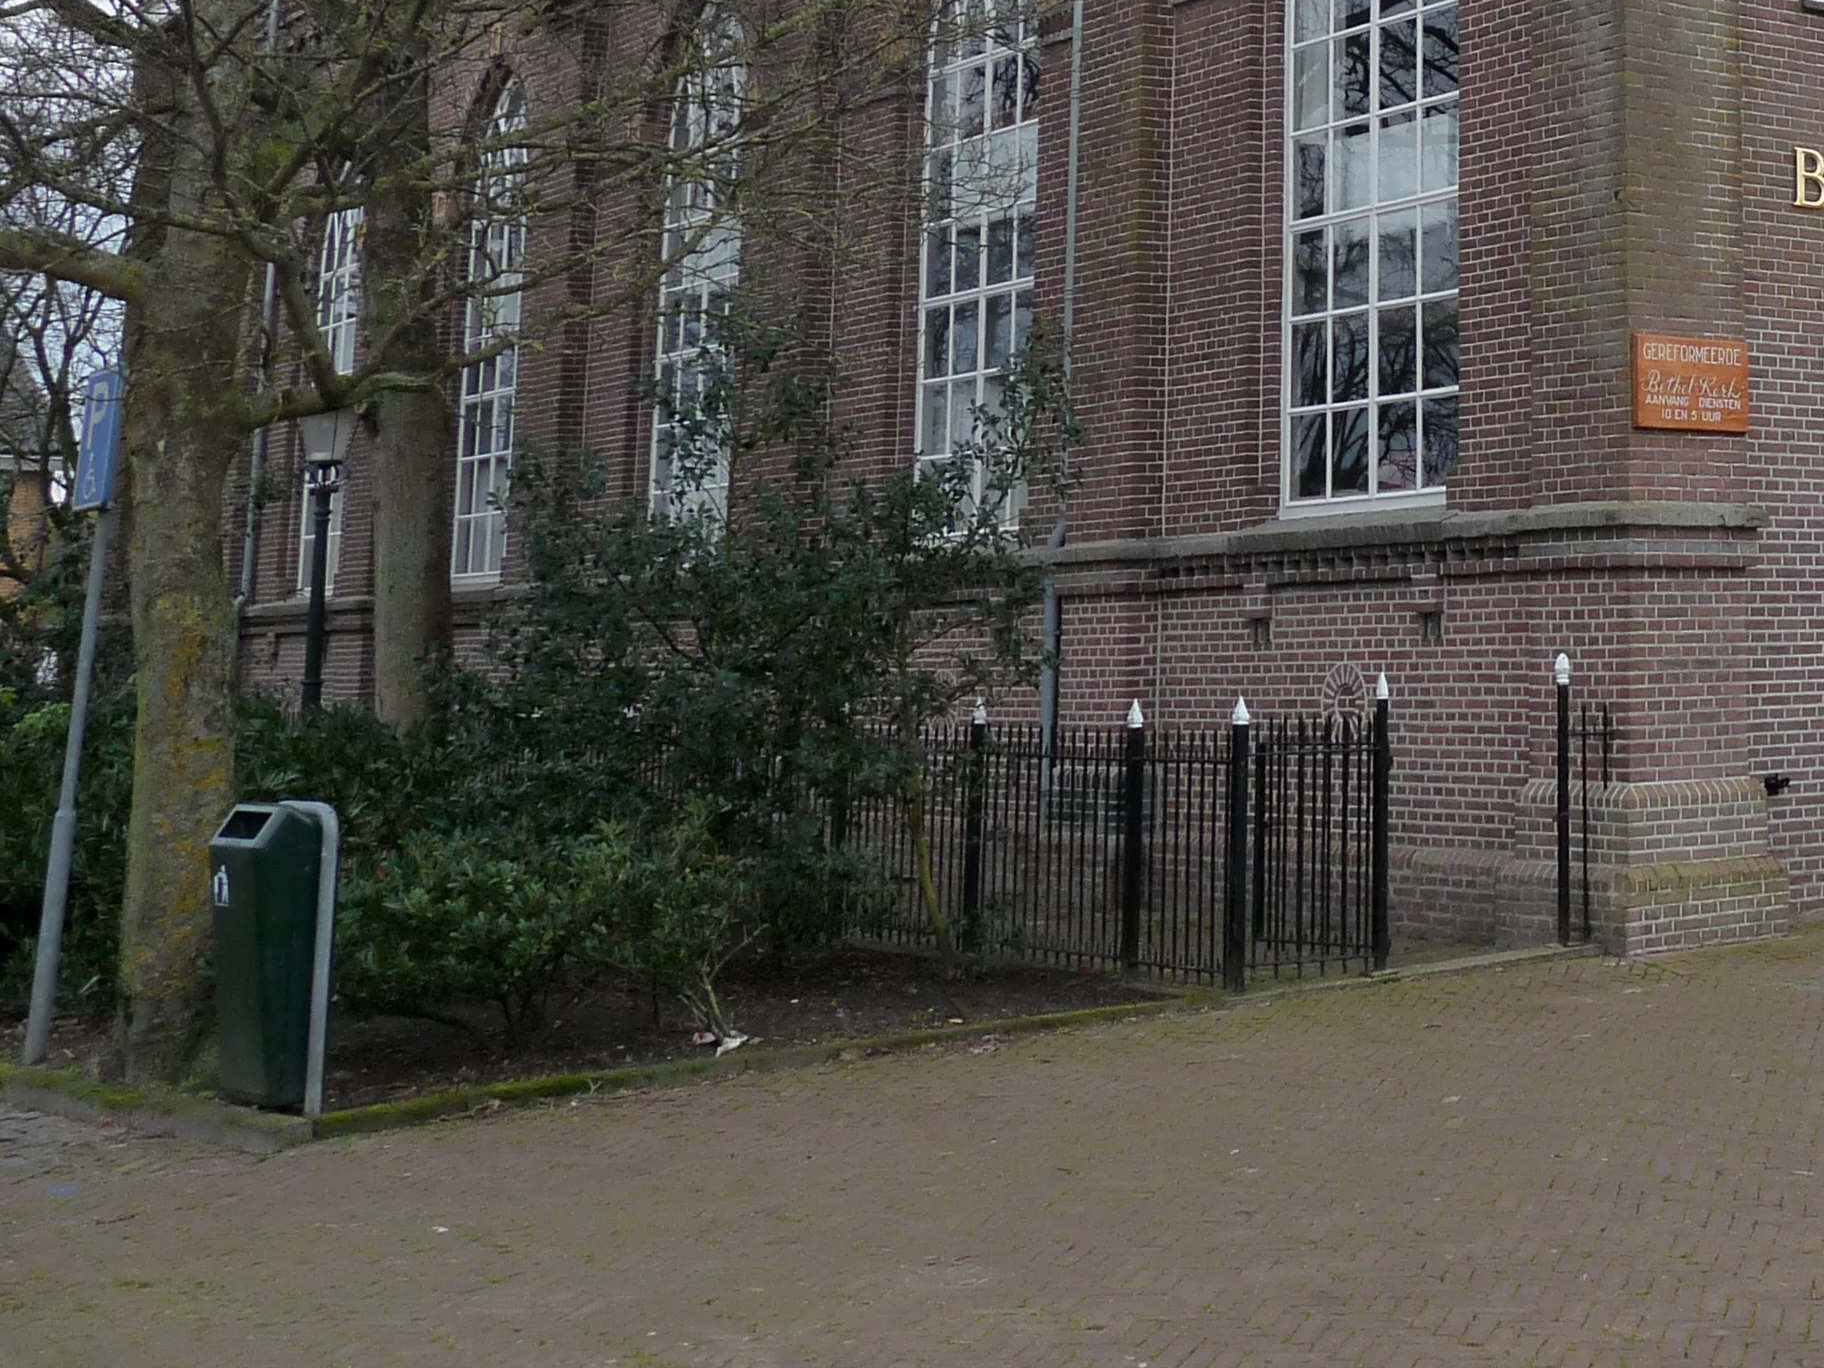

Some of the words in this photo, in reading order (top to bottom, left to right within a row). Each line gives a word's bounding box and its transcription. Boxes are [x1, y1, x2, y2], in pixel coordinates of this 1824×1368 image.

[1643, 342, 1742, 366] GEREFORMEERDE
[1645, 394, 1690, 407] AANVANG
[1698, 396, 1741, 410] DIENSTEN
[86, 381, 109, 450] P
[1661, 408, 1671, 419] 10
[1674, 409, 1688, 420] EN
[1690, 410, 1697, 421] 5
[1701, 410, 1722, 422] UUR
